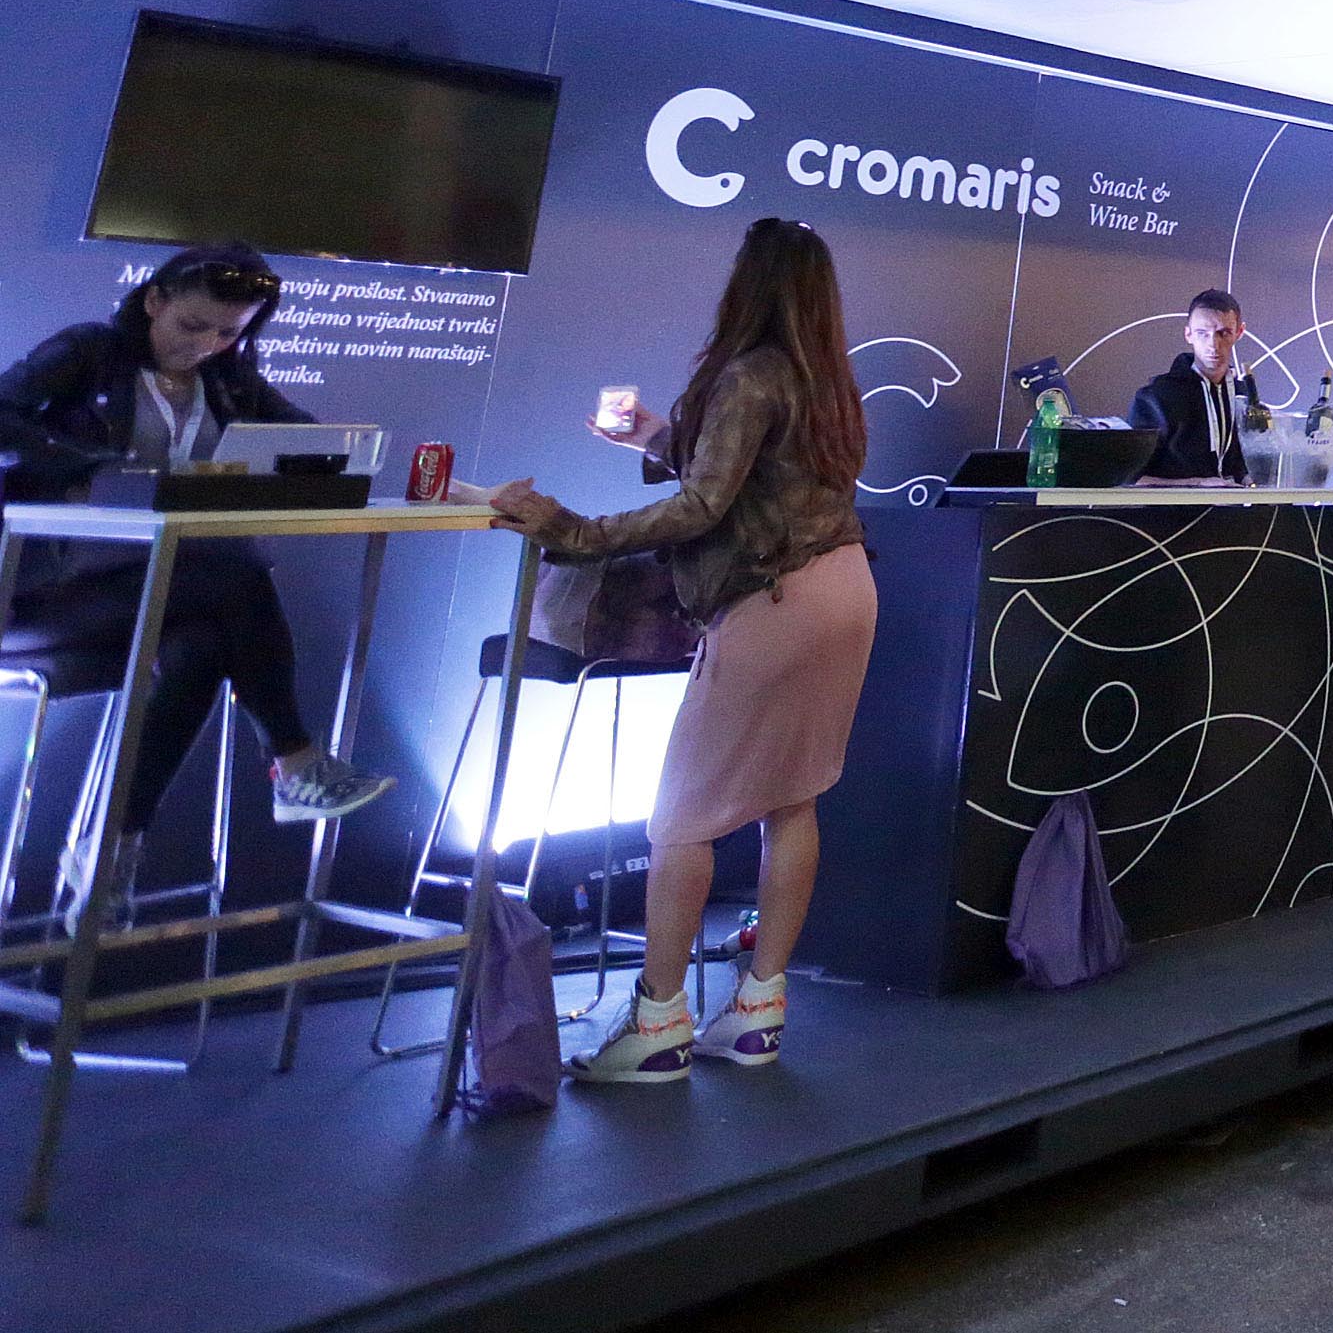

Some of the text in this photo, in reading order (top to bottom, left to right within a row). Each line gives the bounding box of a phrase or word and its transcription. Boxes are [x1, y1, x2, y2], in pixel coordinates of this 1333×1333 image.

[787, 138, 1061, 218] cromaris
[1089, 171, 1171, 203] Snack &
[1089, 203, 1179, 236] Wine Bar
[280, 278, 331, 300] svoju
[330, 281, 407, 302] prošlost.
[411, 285, 496, 307] Stvaramo
[356, 312, 446, 334] vrijednost
[447, 317, 498, 335] tvrtki
[343, 340, 404, 358] novim
[407, 344, 492, 366] naraštaji-
